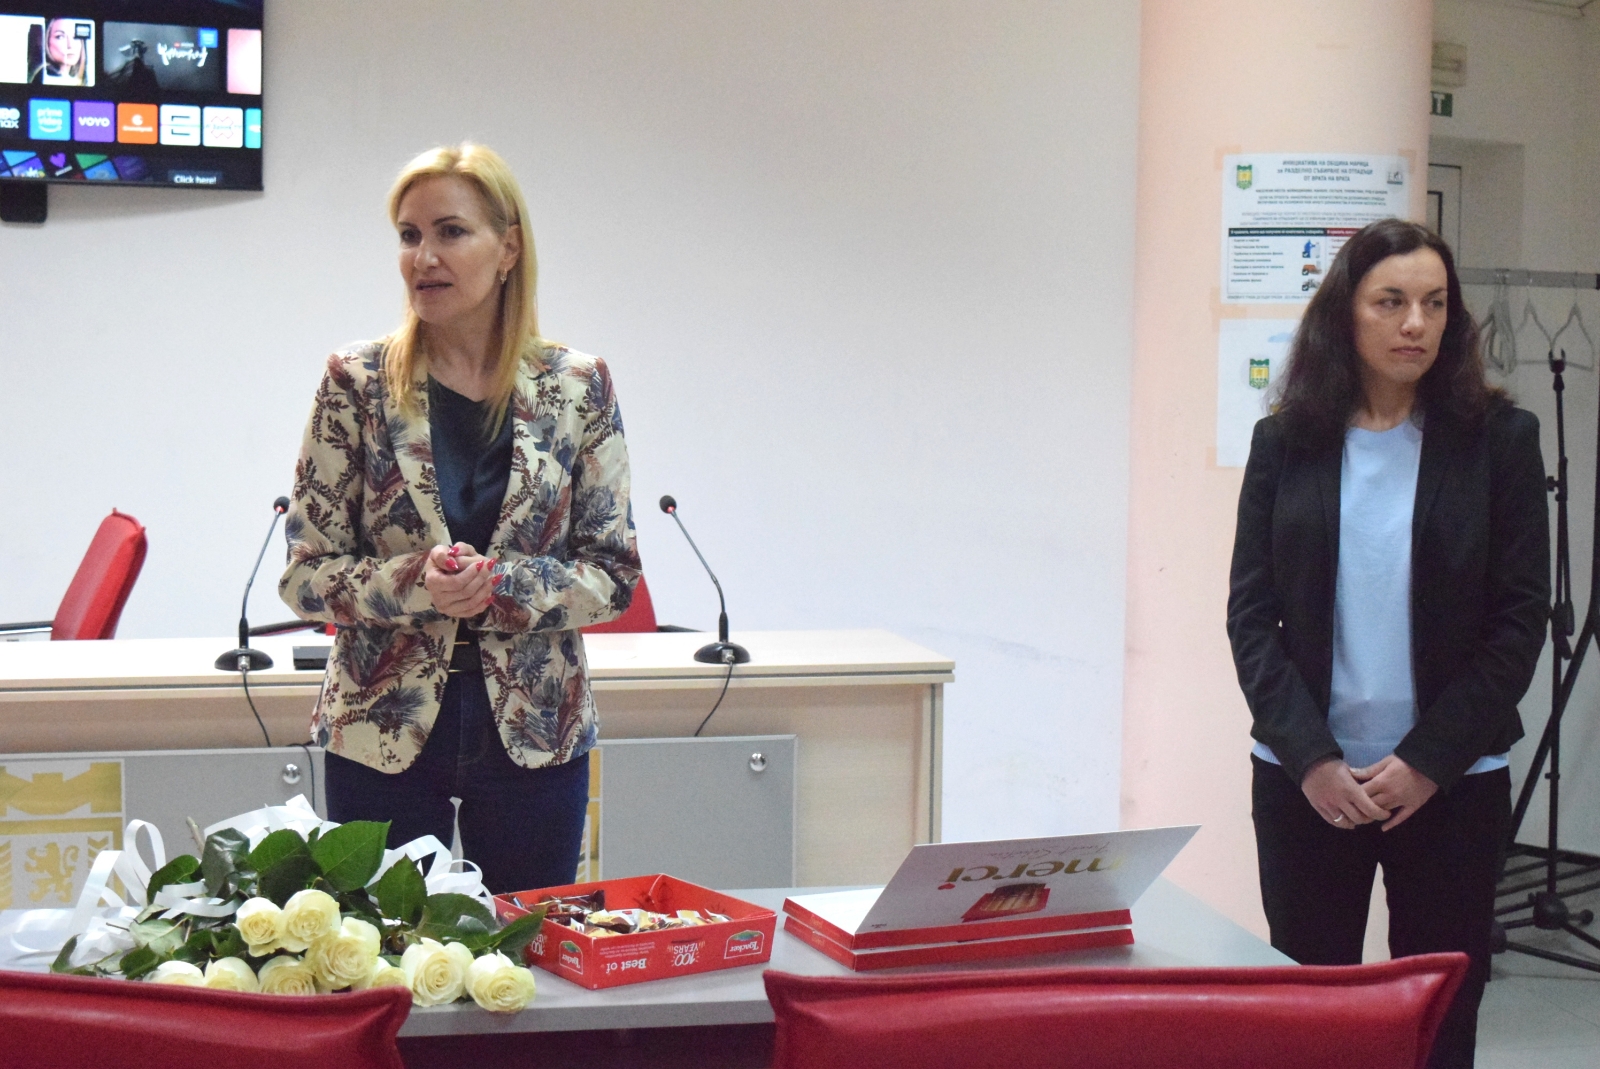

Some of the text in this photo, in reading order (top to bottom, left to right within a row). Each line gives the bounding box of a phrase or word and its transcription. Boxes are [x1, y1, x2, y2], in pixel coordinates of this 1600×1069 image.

[0, 107, 20, 120] BO
[173, 174, 217, 185] Click here!
[938, 855, 1121, 890] merci
[673, 942, 699, 955] YEARS
[728, 940, 759, 955] Loacker
[605, 958, 647, 974] Best of
[674, 952, 696, 967] 100
